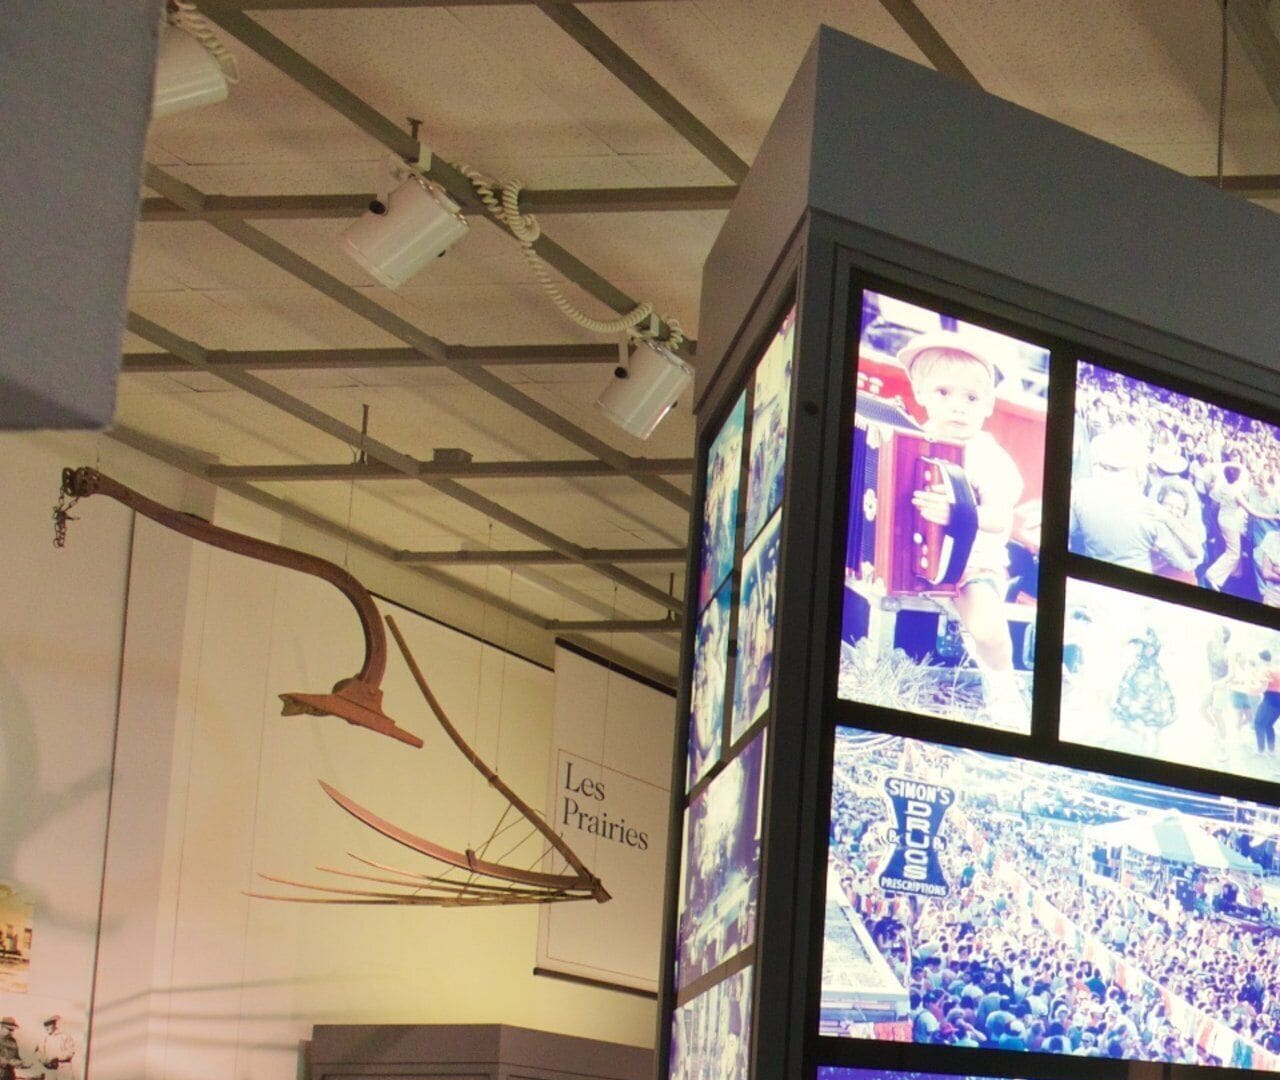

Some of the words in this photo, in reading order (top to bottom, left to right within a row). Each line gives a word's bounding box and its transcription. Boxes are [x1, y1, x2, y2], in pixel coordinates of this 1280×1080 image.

[565, 761, 605, 801] Les
[889, 780, 951, 805] SIMON'S
[562, 797, 648, 850] Prairies
[903, 800, 932, 880] DRUGS
[881, 877, 947, 896] PRESCRIPTIONS
